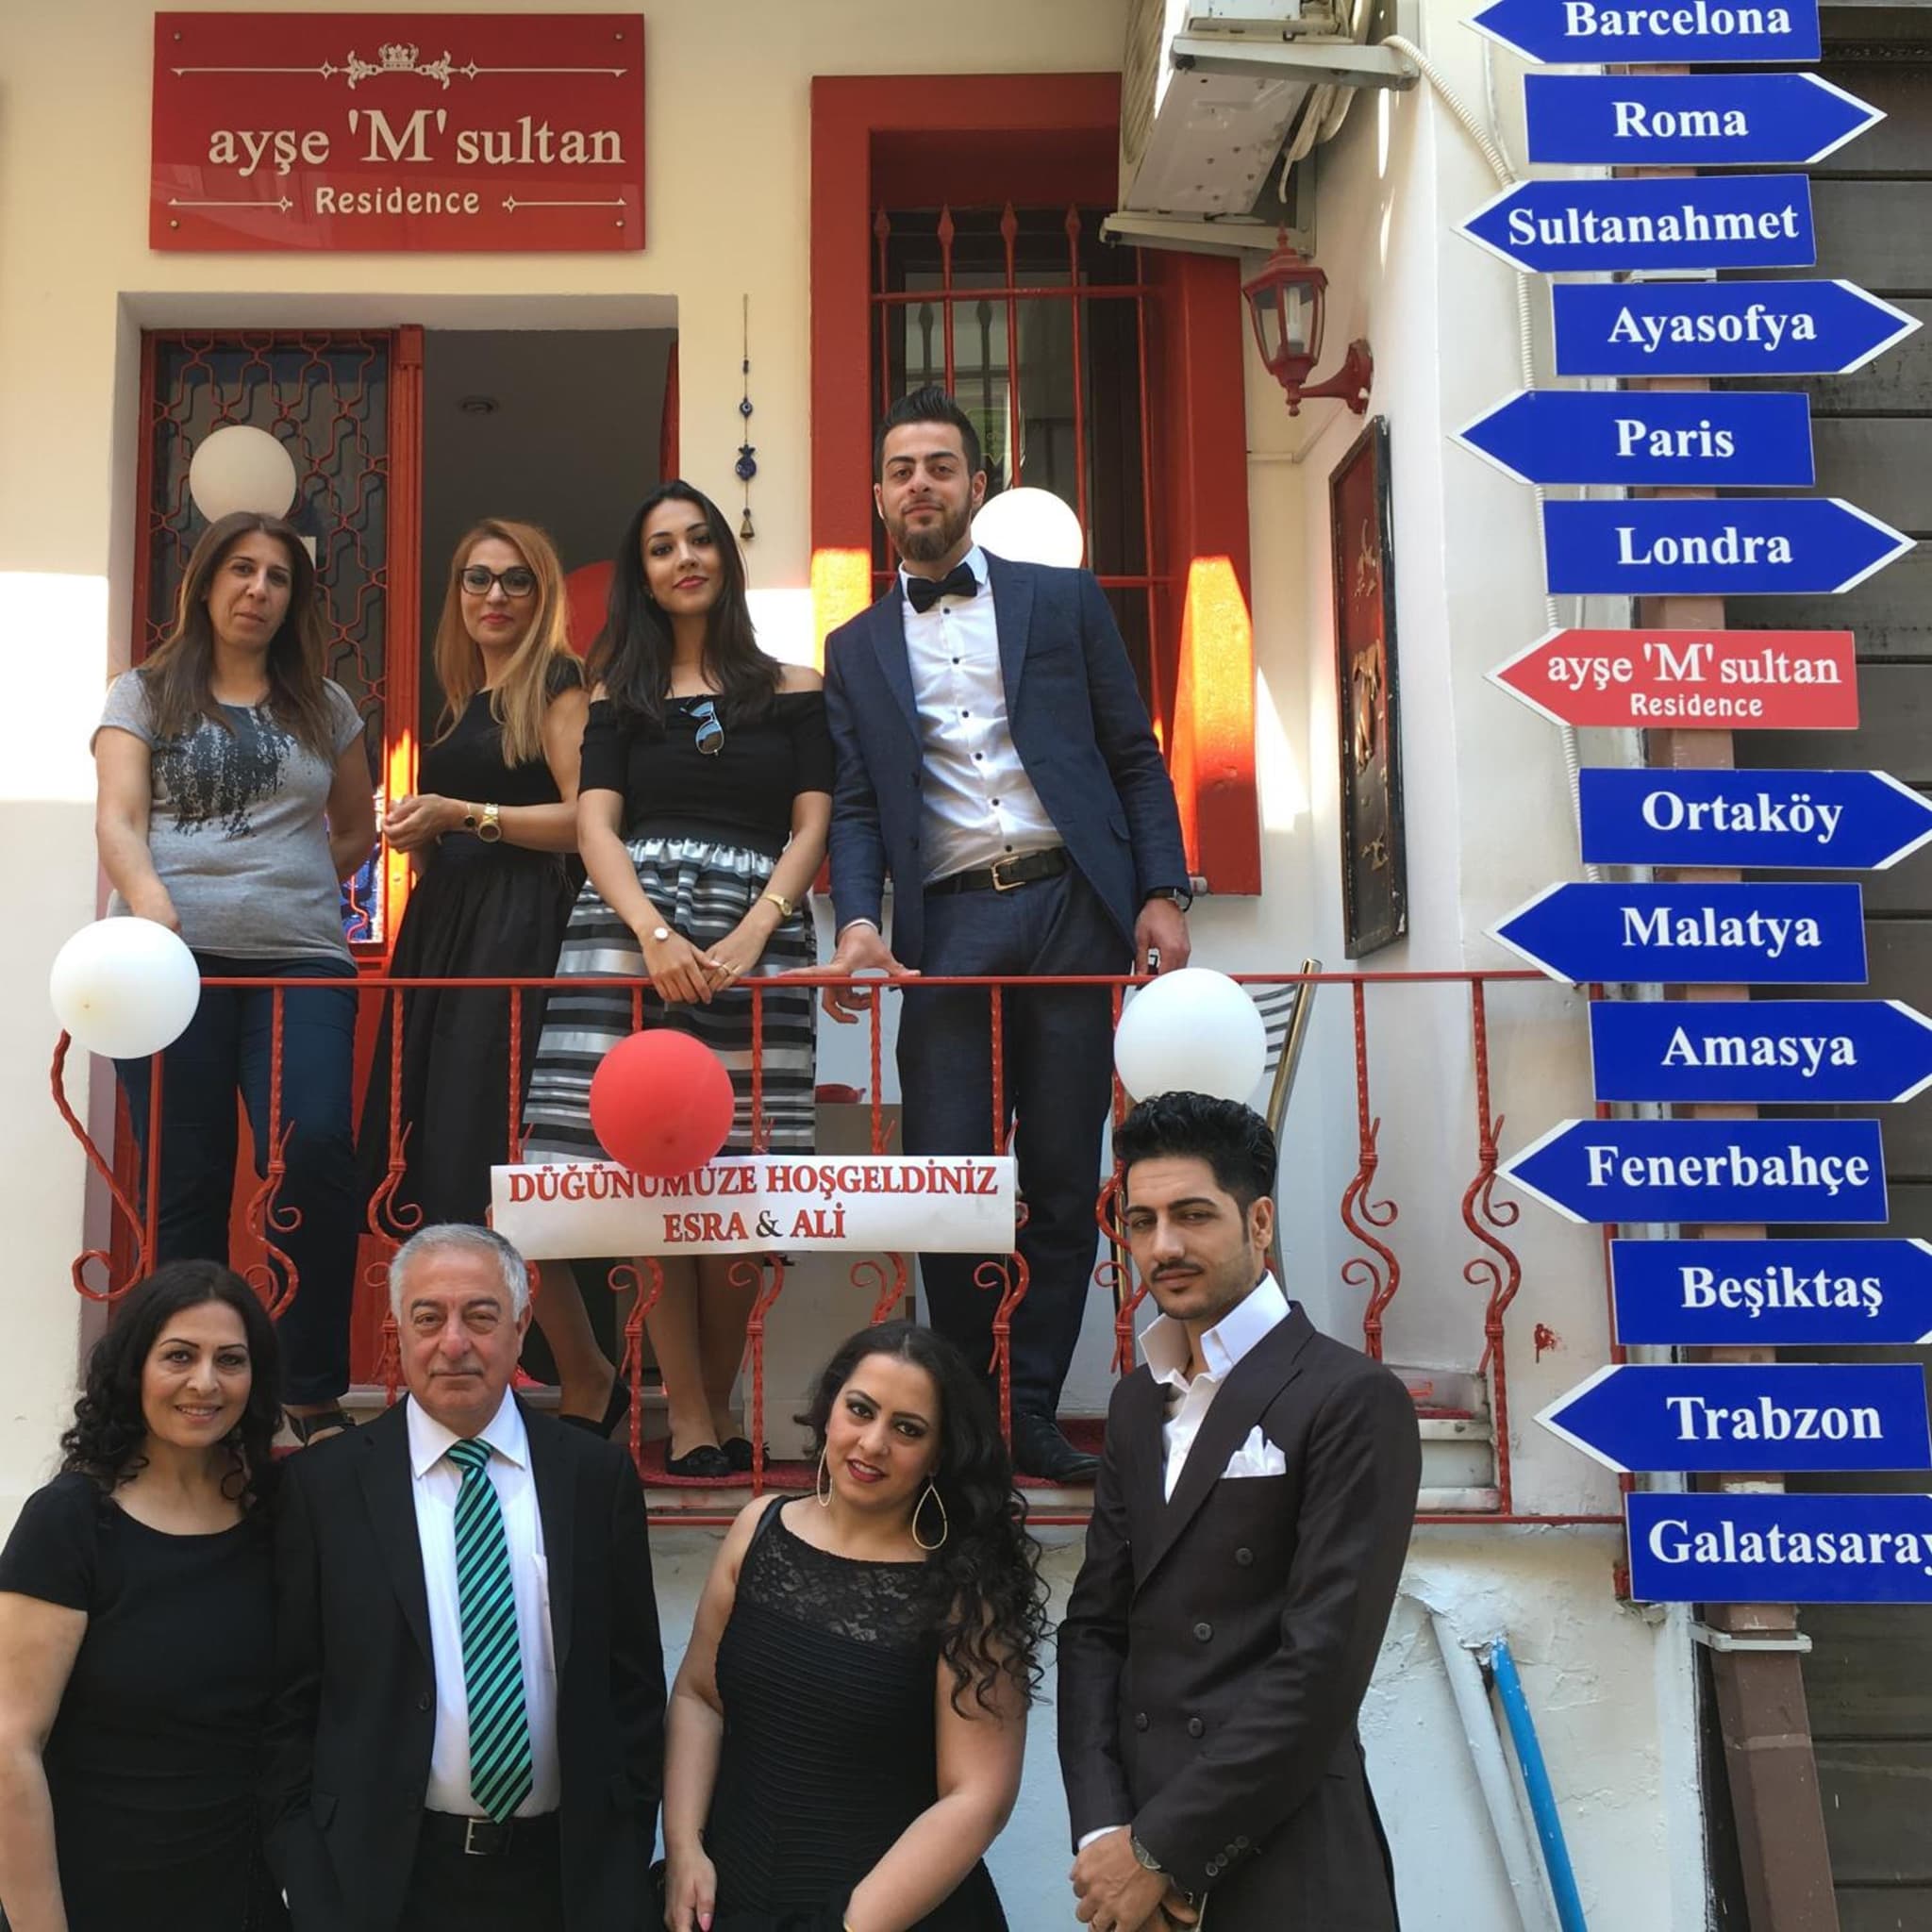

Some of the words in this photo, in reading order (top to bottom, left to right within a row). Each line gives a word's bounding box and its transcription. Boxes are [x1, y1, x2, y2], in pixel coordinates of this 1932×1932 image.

[1563, 1, 1791, 36] Barcelona
[1612, 102, 1748, 137] Roma
[209, 131, 328, 175] ayşe
[458, 116, 625, 163] sultan
[317, 187, 478, 213] Residence
[1509, 205, 1799, 245] Sultanahmet
[1607, 305, 1816, 352] Ayasofya
[1615, 420, 1734, 457] Paris
[1616, 527, 1792, 564] Londra
[1548, 657, 1632, 691] ayşe
[1721, 649, 1841, 683] sultan
[1631, 693, 1762, 716] Residence
[1642, 791, 1842, 843] Ortaköy
[1622, 908, 1821, 958] Malatya
[1662, 1027, 1857, 1076] Amasya
[766, 1158, 999, 1200] HOŞGELDİNİZ
[1585, 1146, 1869, 1195] Fenerbahçe
[663, 1211, 748, 1243] ESRA
[757, 1211, 782, 1237] &
[791, 1203, 846, 1239] ALİ
[1680, 1267, 1882, 1317] Beşiktaş
[1667, 1397, 1882, 1440] Trabzon
